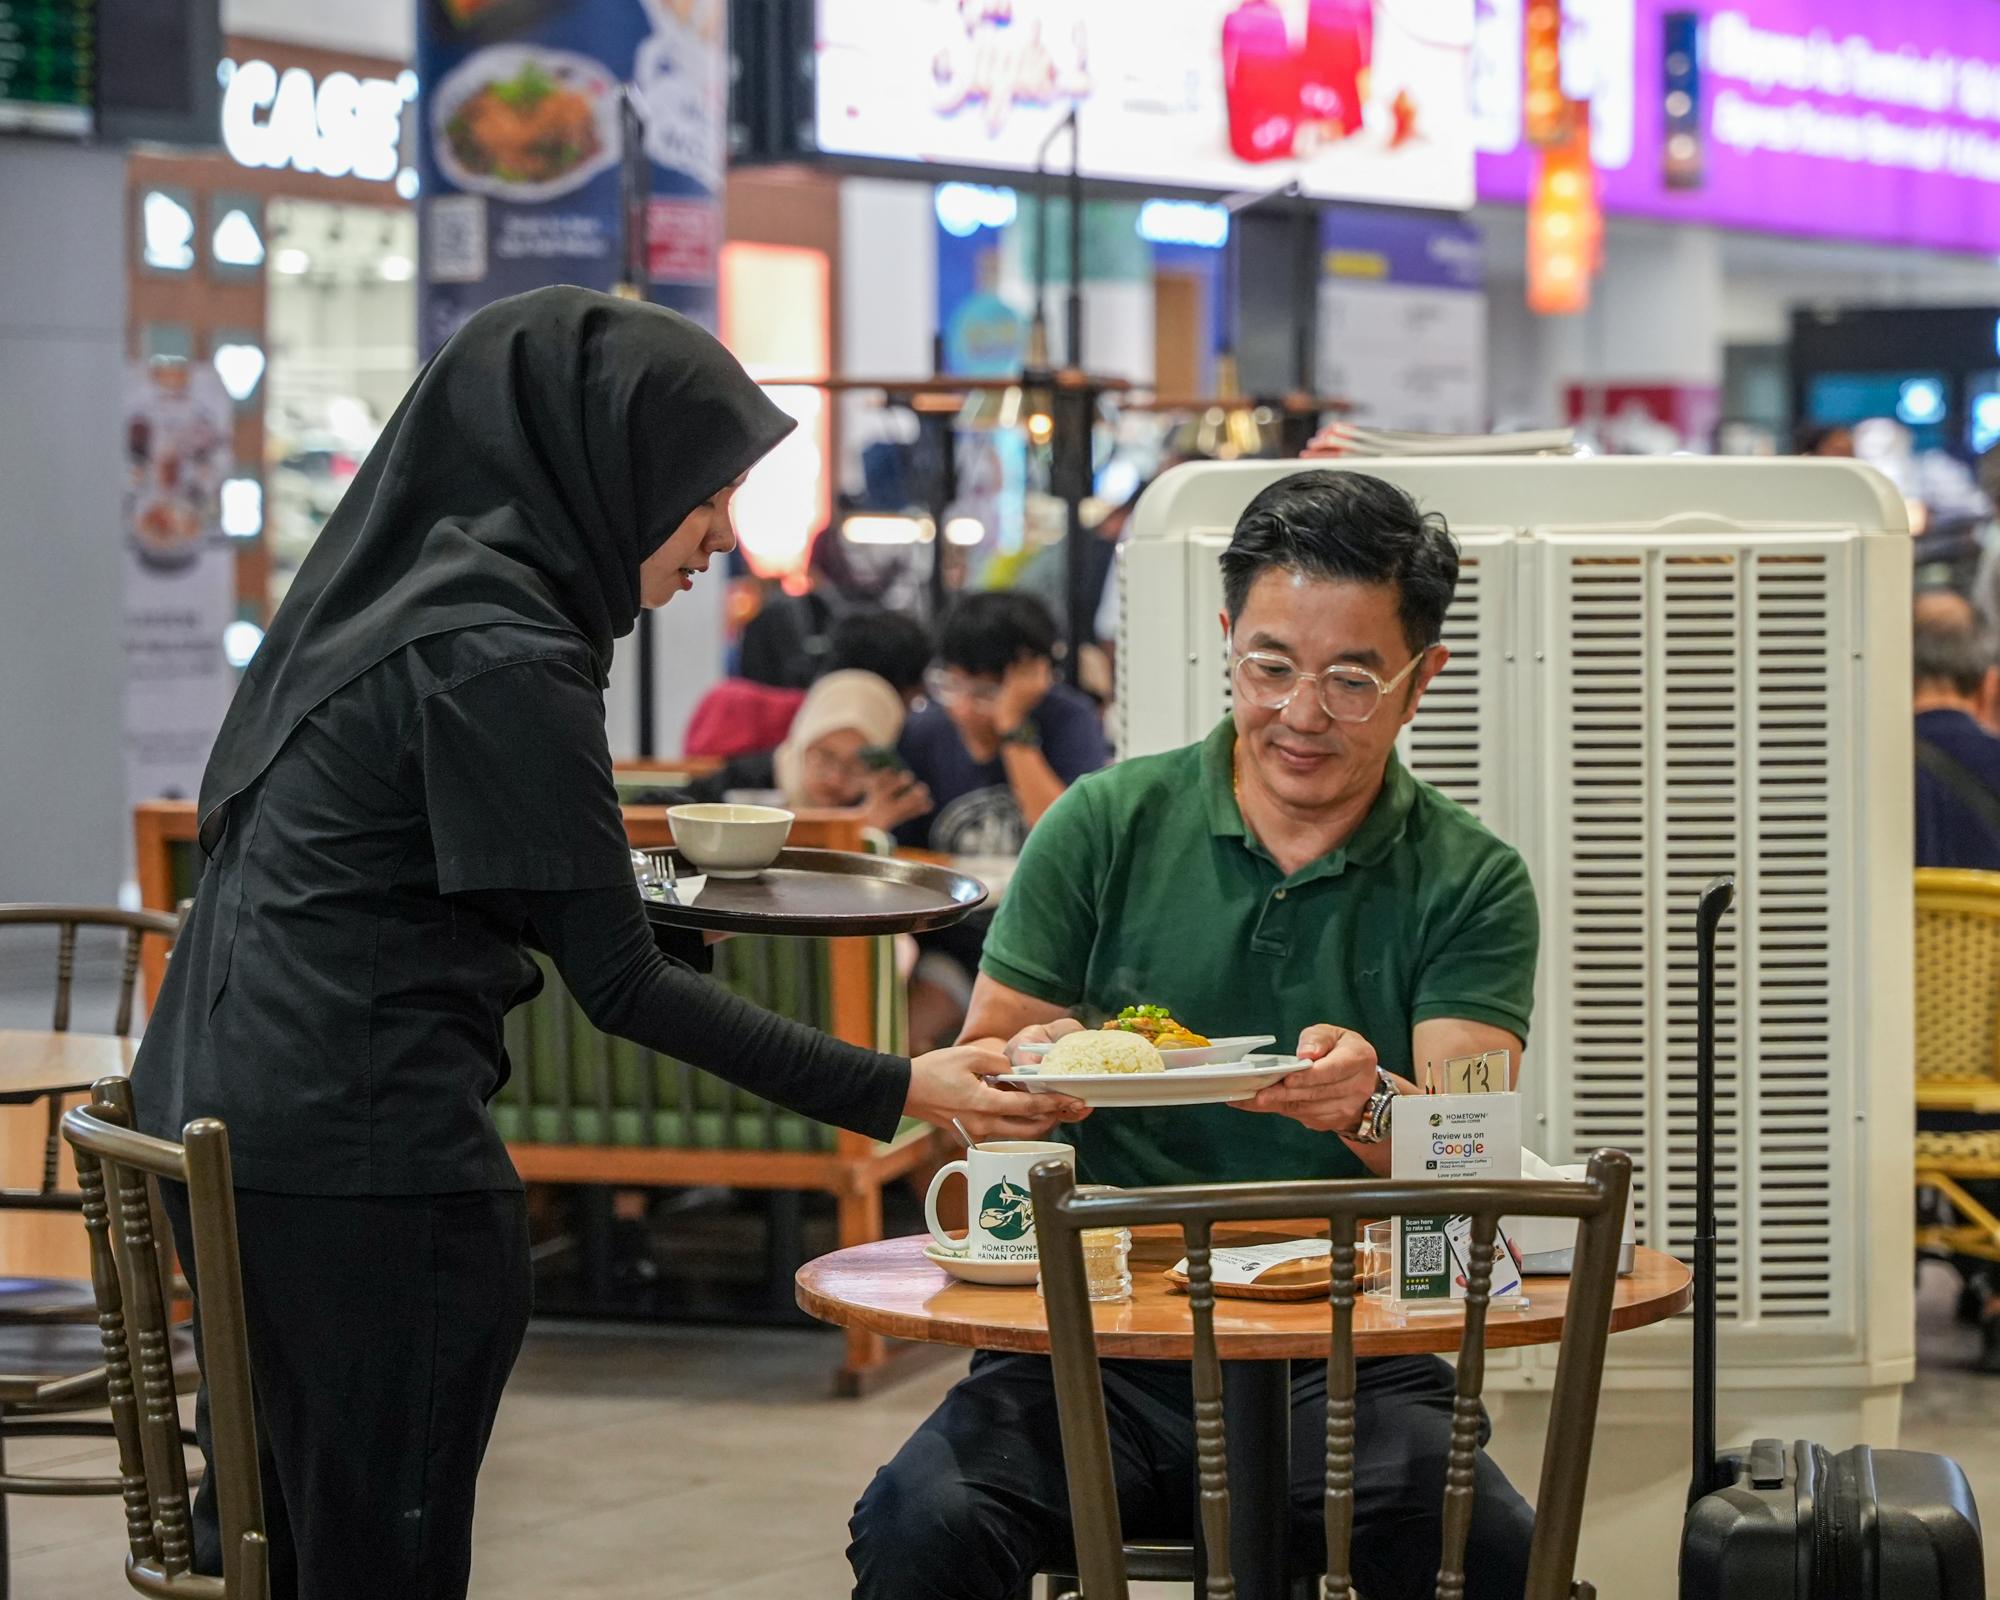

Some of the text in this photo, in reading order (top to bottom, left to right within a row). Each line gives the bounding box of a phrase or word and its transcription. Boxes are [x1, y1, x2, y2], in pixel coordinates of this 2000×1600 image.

[1432, 1132, 1461, 1140] Review
[1433, 1140, 1484, 1157] Google
[977, 1252, 1007, 1260] HAINAN
